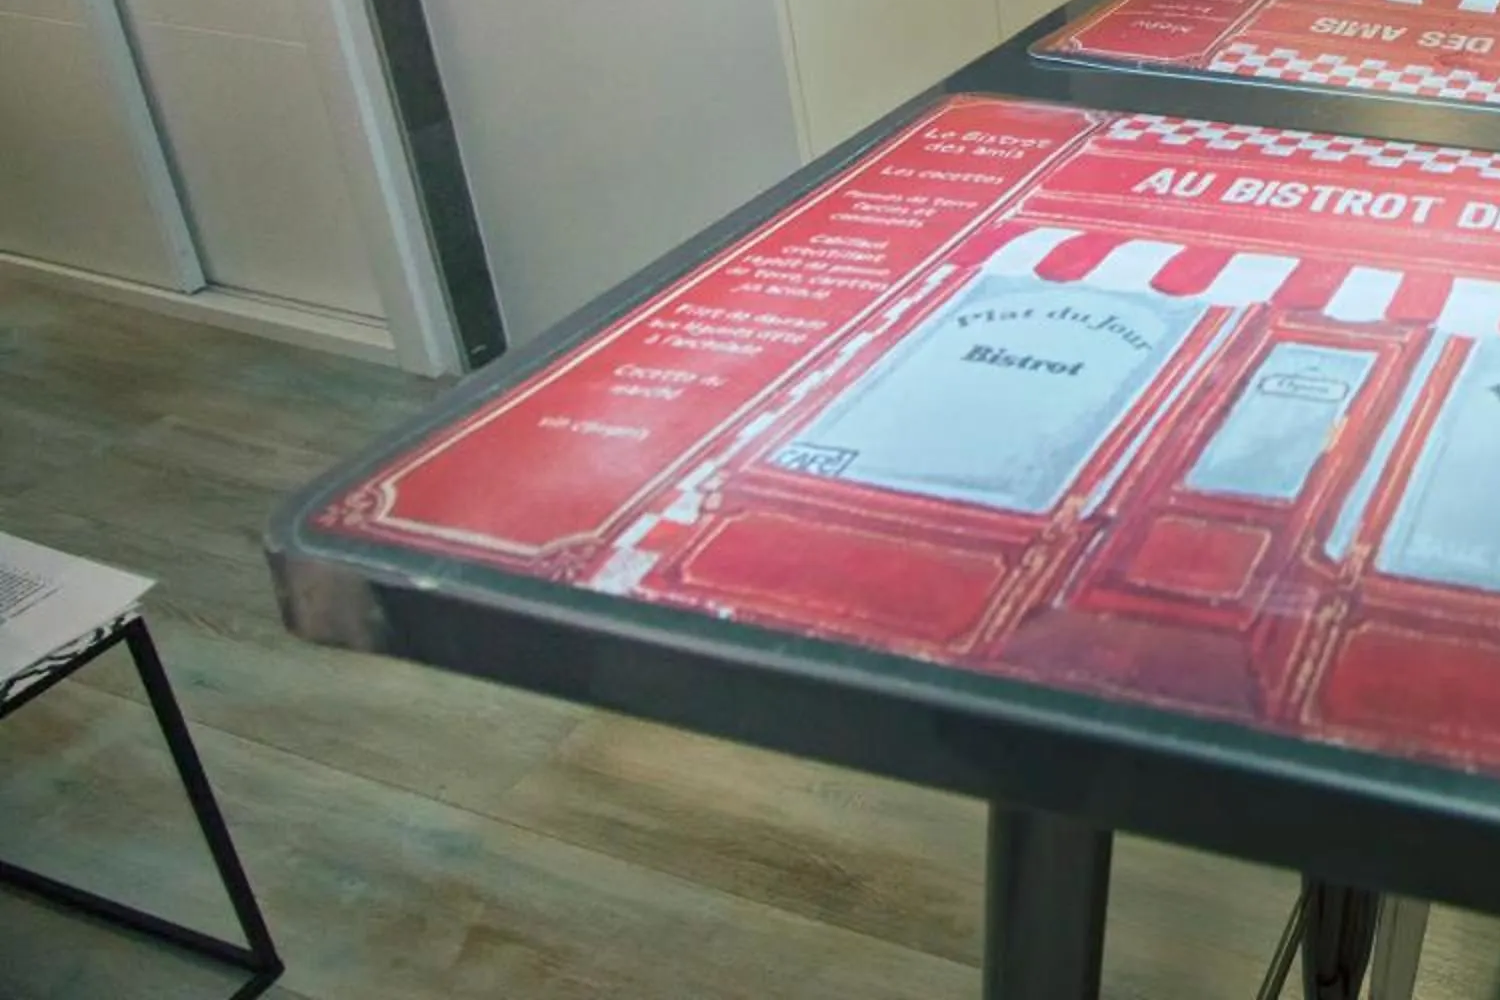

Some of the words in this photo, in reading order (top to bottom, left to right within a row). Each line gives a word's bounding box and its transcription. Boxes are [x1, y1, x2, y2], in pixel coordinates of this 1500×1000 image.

[1309, 16, 1409, 42] AMIS
[1417, 30, 1495, 53] DES
[1131, 166, 1217, 199] AU
[1220, 178, 1444, 226] BISTROT
[960, 343, 1086, 377] Bistrot
